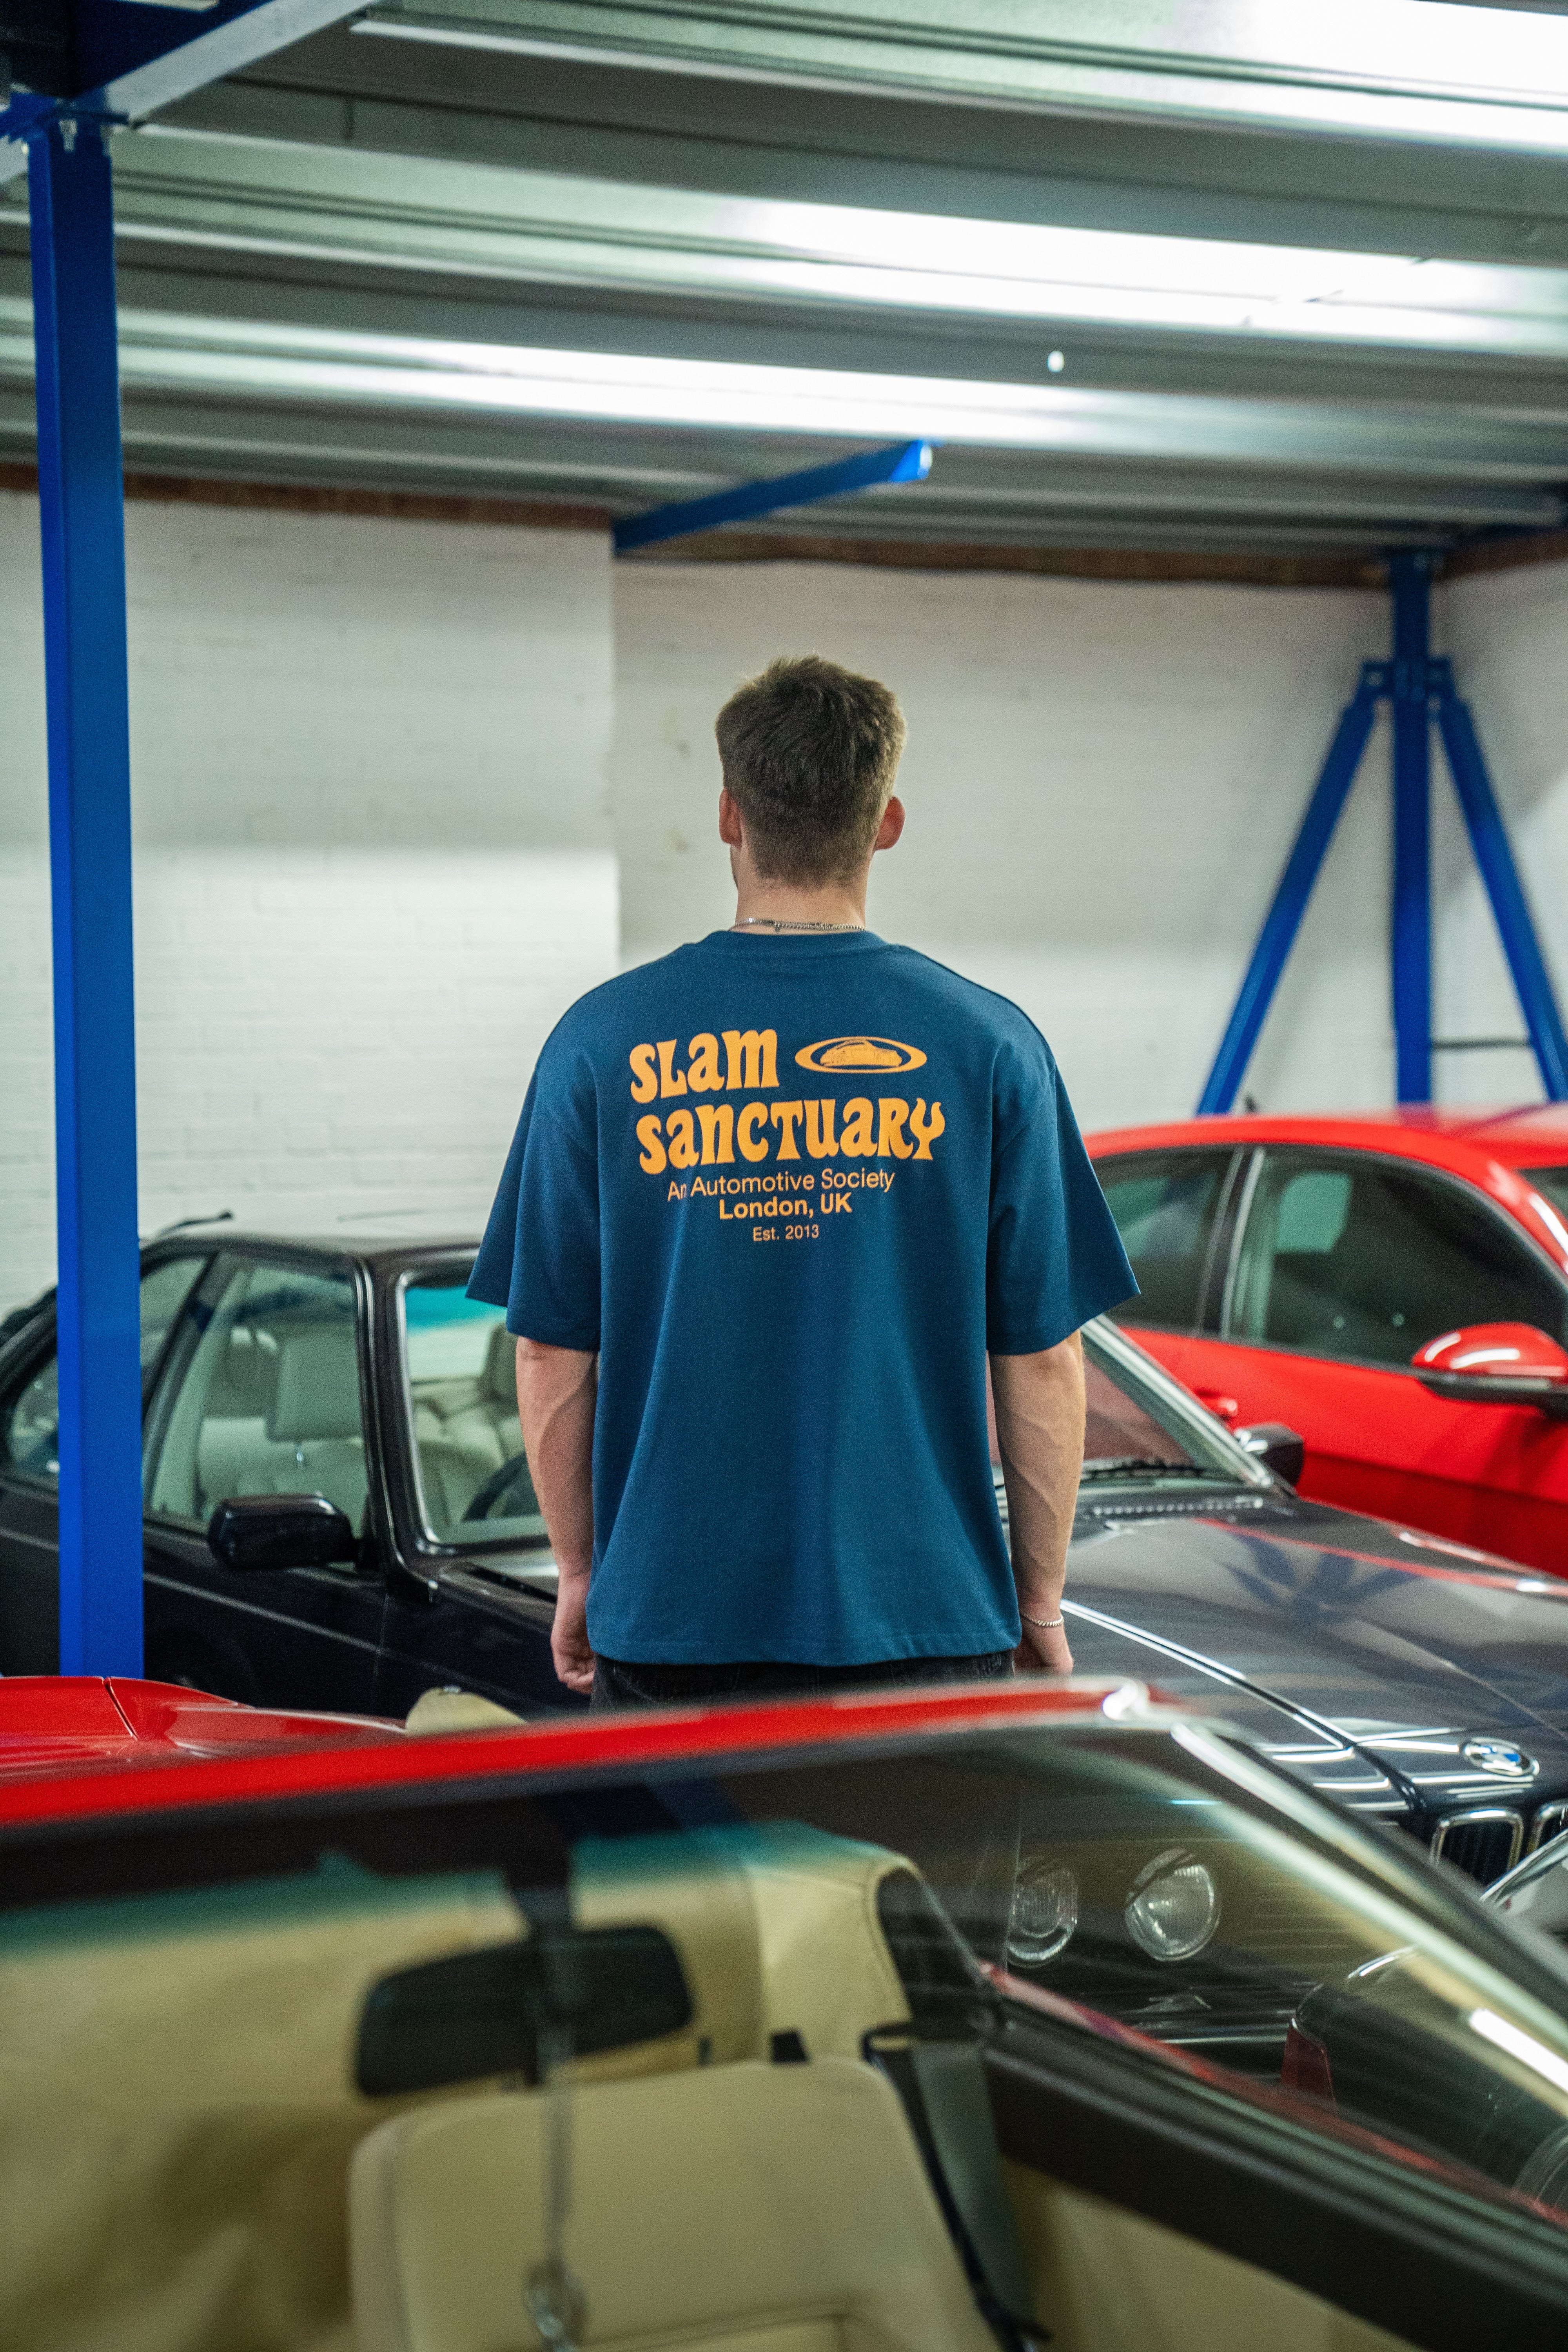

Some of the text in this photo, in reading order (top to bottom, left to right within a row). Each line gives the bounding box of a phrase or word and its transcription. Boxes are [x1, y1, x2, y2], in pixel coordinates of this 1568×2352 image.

[667, 1168, 895, 1201] An Automotive Society
[719, 1192, 853, 1220] London, UK
[753, 1224, 819, 1242] Est. 2013
